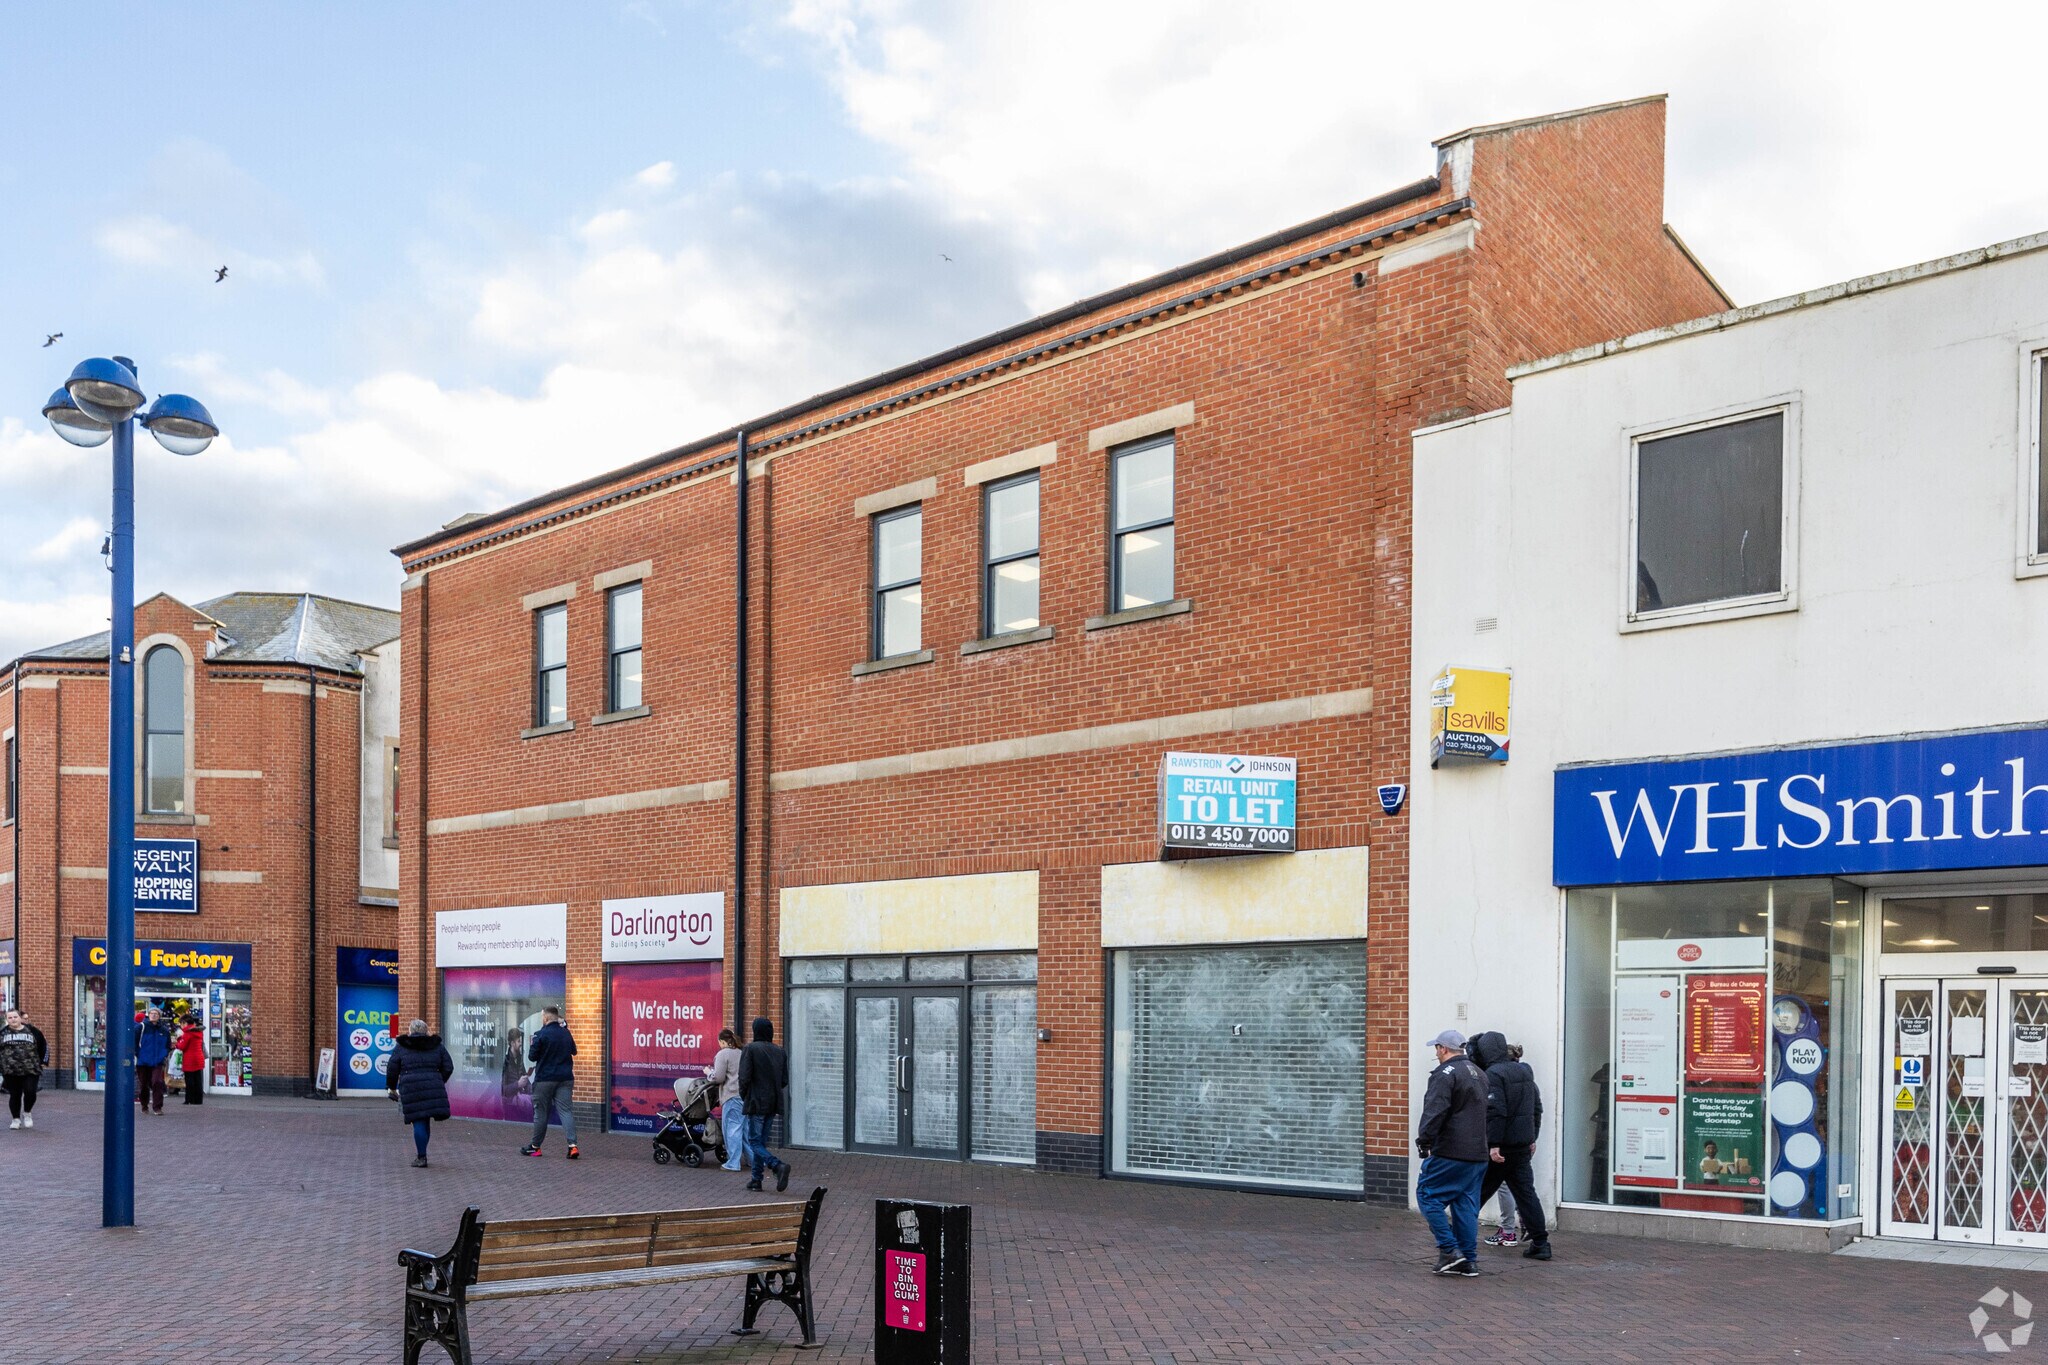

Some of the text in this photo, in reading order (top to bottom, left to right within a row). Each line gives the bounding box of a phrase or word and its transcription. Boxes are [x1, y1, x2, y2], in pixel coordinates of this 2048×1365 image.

[1450, 711, 1505, 732] savills
[1446, 733, 1486, 744] AUCTION
[1460, 742, 1476, 751] 7824
[1476, 744, 1492, 752] 9091
[1171, 757, 1291, 772] RAWSTRON JOHNSON
[1183, 777, 1279, 797] RETAIL UNIT
[1178, 794, 1284, 825] TO LET
[1590, 757, 2048, 860] WHSmith
[1171, 824, 1290, 844] 0113 450 7000
[134, 876, 193, 890] HOPPING
[441, 921, 501, 935] People helping people
[611, 908, 713, 942] Darlington
[457, 937, 560, 952] Rewarding membership and loyalty
[610, 938, 666, 949] Building Society
[150, 949, 234, 973] Factory
[370, 959, 399, 968] Compar
[1739, 980, 1760, 989] Change
[457, 1003, 491, 1016] Because
[631, 1000, 704, 1020] We're here
[344, 1009, 399, 1026] CARD
[453, 1018, 495, 1031] we're here
[450, 1033, 498, 1049] for all of you
[632, 1028, 703, 1049] for Redcar
[1792, 1048, 1817, 1057] PLAY
[656, 1062, 672, 1071] helping
[1792, 1056, 1816, 1065] NOW
[617, 1116, 653, 1128] Volunteering
[895, 1256, 917, 1267] TIME
[899, 1265, 912, 1274] TO
[898, 1273, 914, 1283] BIN
[893, 1281, 919, 1293] YOUR
[894, 1290, 920, 1301] GUM?
